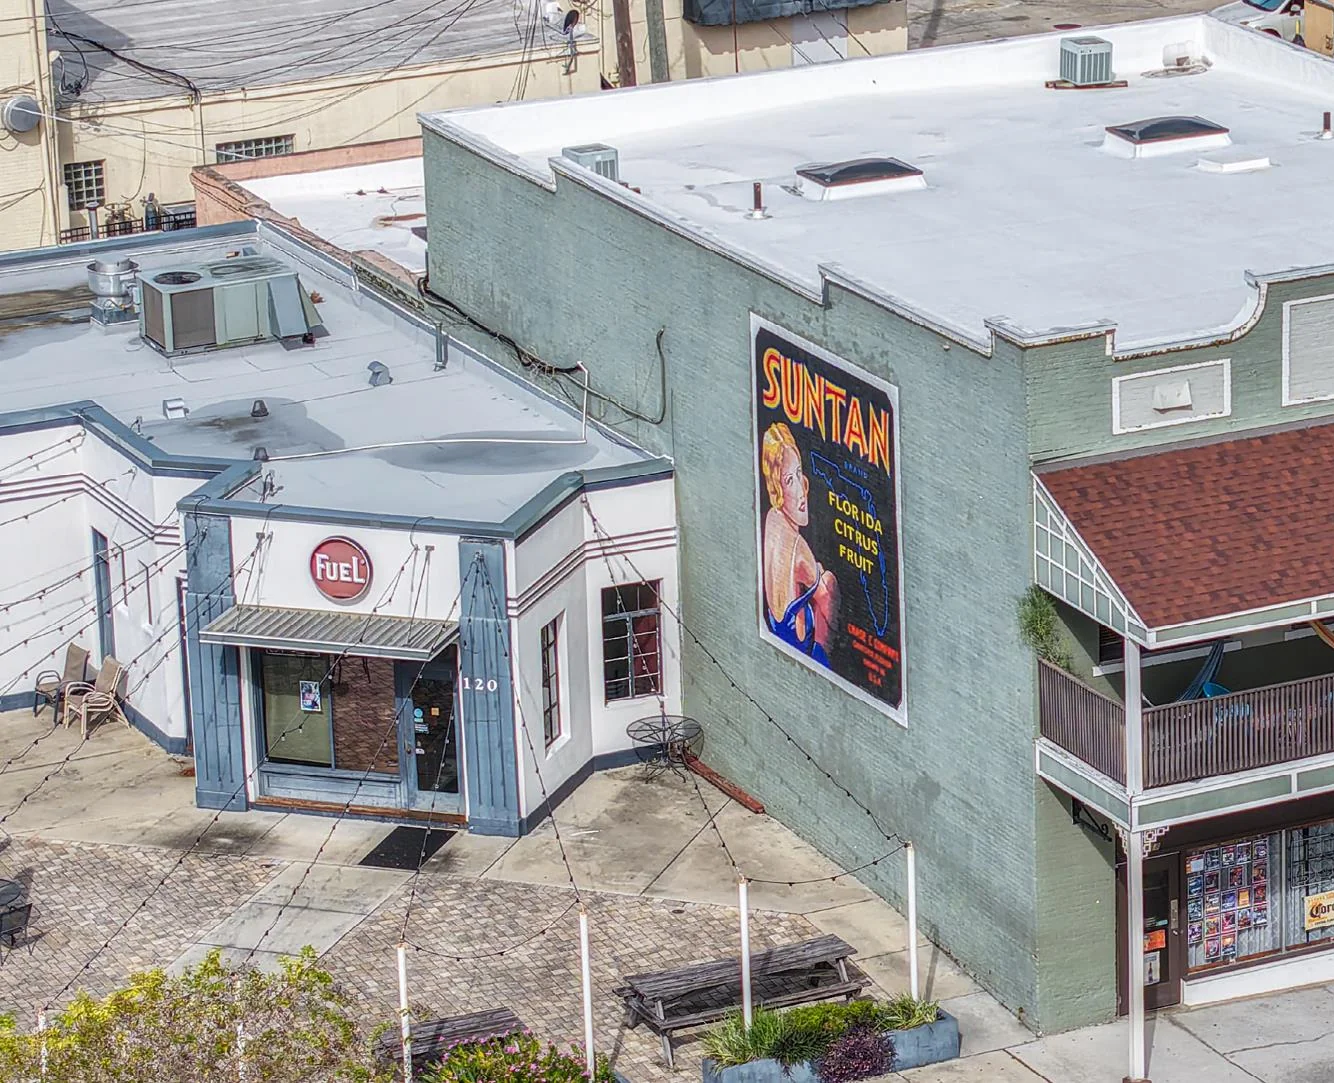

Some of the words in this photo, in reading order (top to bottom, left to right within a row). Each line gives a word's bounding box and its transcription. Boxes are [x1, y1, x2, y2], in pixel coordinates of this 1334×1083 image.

[763, 347, 890, 479] SUNTAN
[828, 490, 883, 536] FLORIDA
[834, 518, 879, 556] CITRUS
[839, 543, 874, 574] FRUIT
[463, 677, 498, 692] 120
